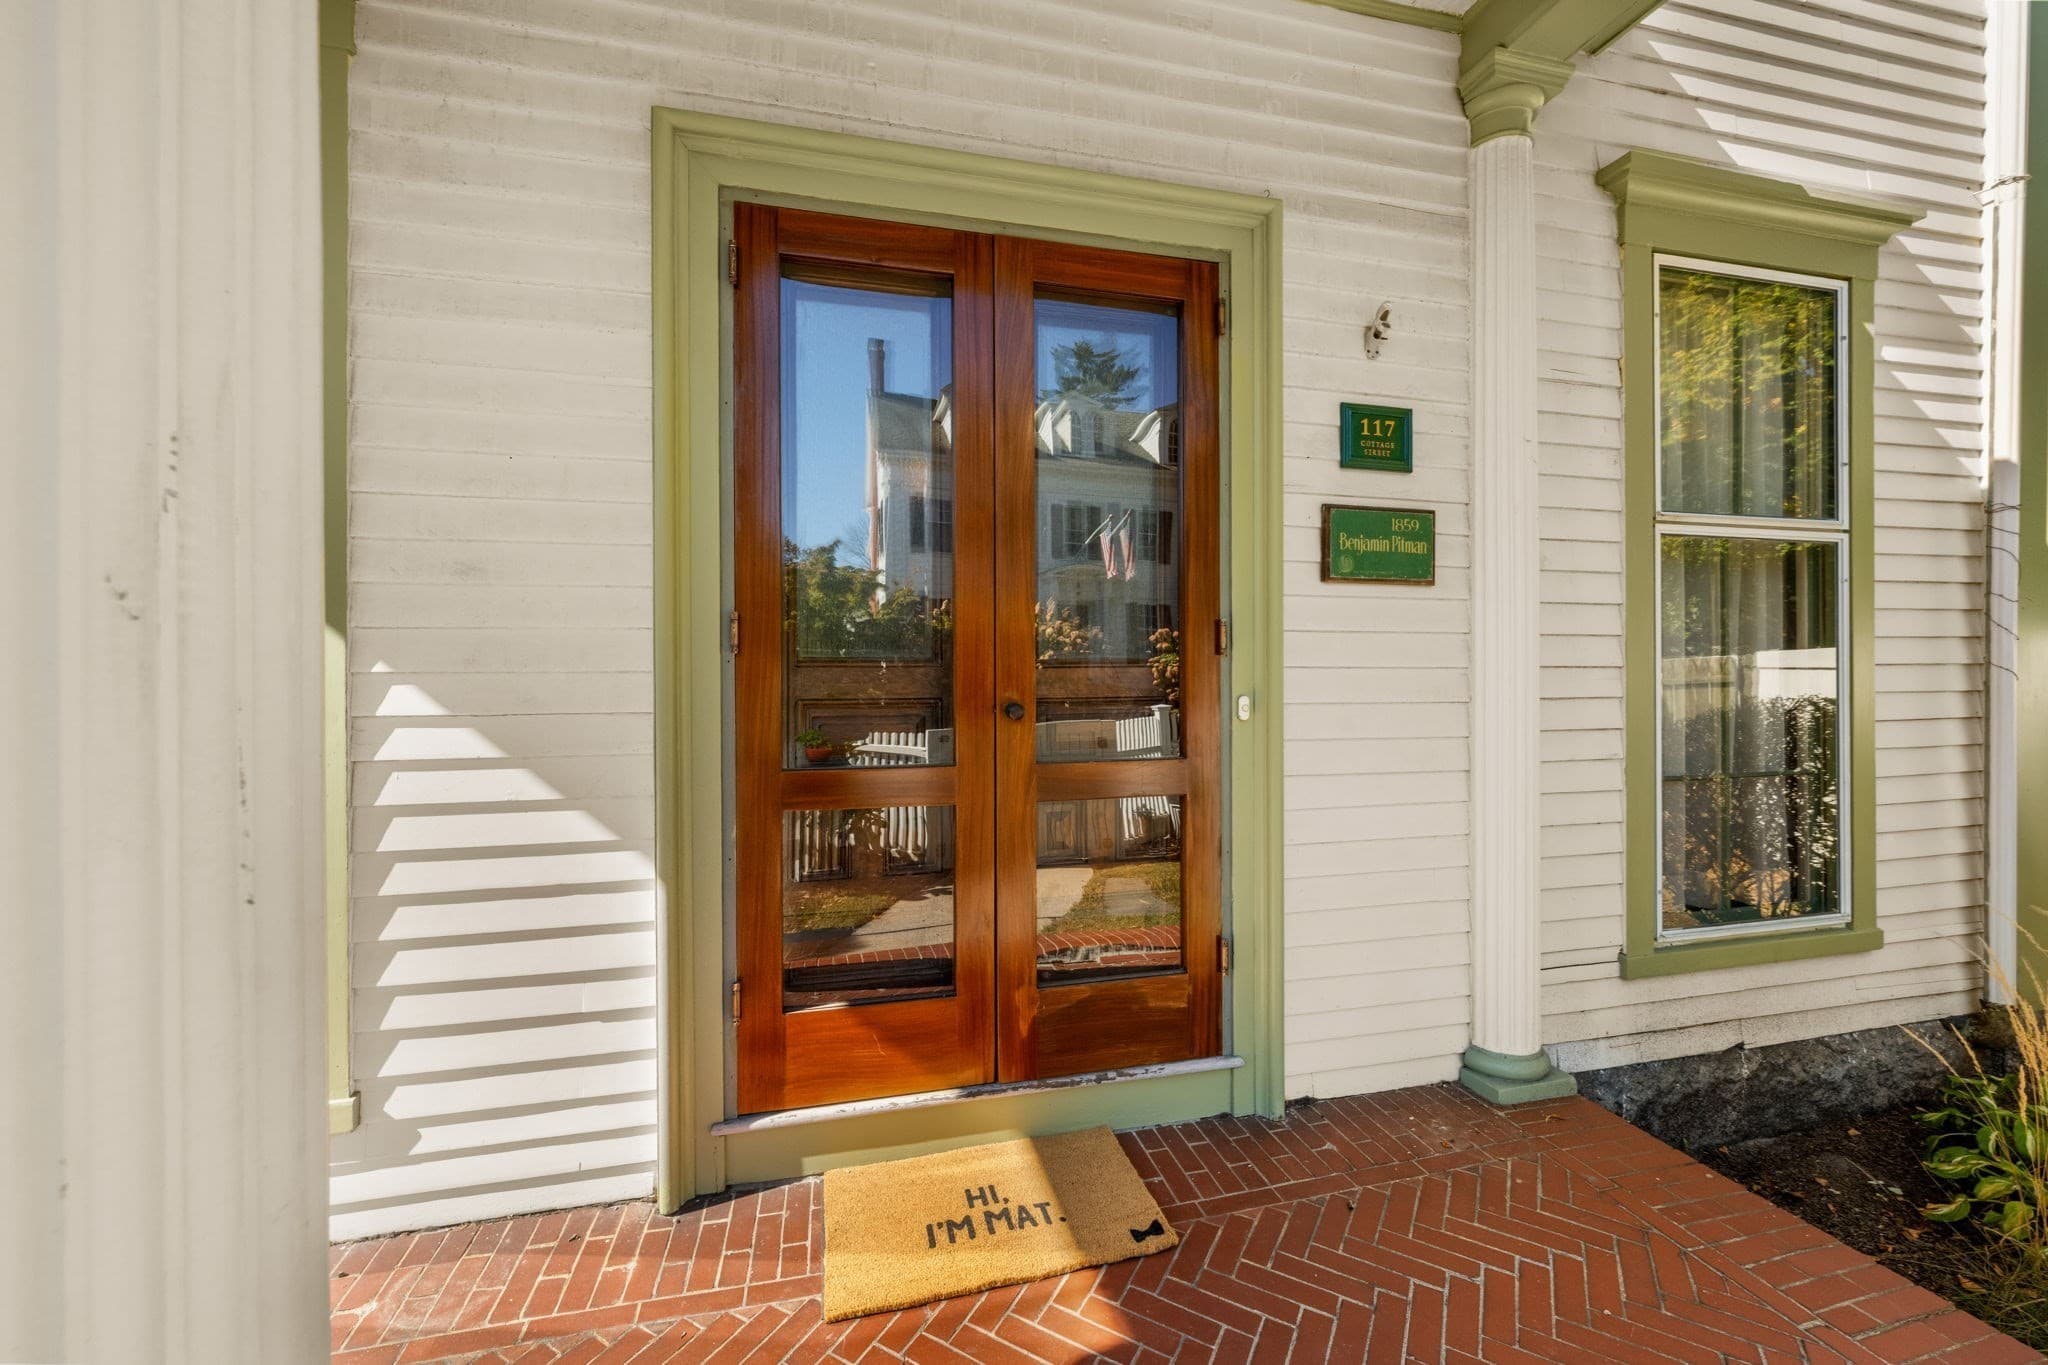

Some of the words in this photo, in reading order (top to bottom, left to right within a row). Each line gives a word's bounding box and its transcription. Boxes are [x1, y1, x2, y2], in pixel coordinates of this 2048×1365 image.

[1360, 417, 1396, 437] 117
[1360, 440, 1395, 449] COTTAGE
[1364, 449, 1391, 457] STREET
[1391, 518, 1419, 532] 1859
[1339, 532, 1390, 555] Benjamin
[1391, 535, 1427, 554] Pitman
[925, 1214, 976, 1249] I'M
[983, 1201, 1067, 1235] MAT.
